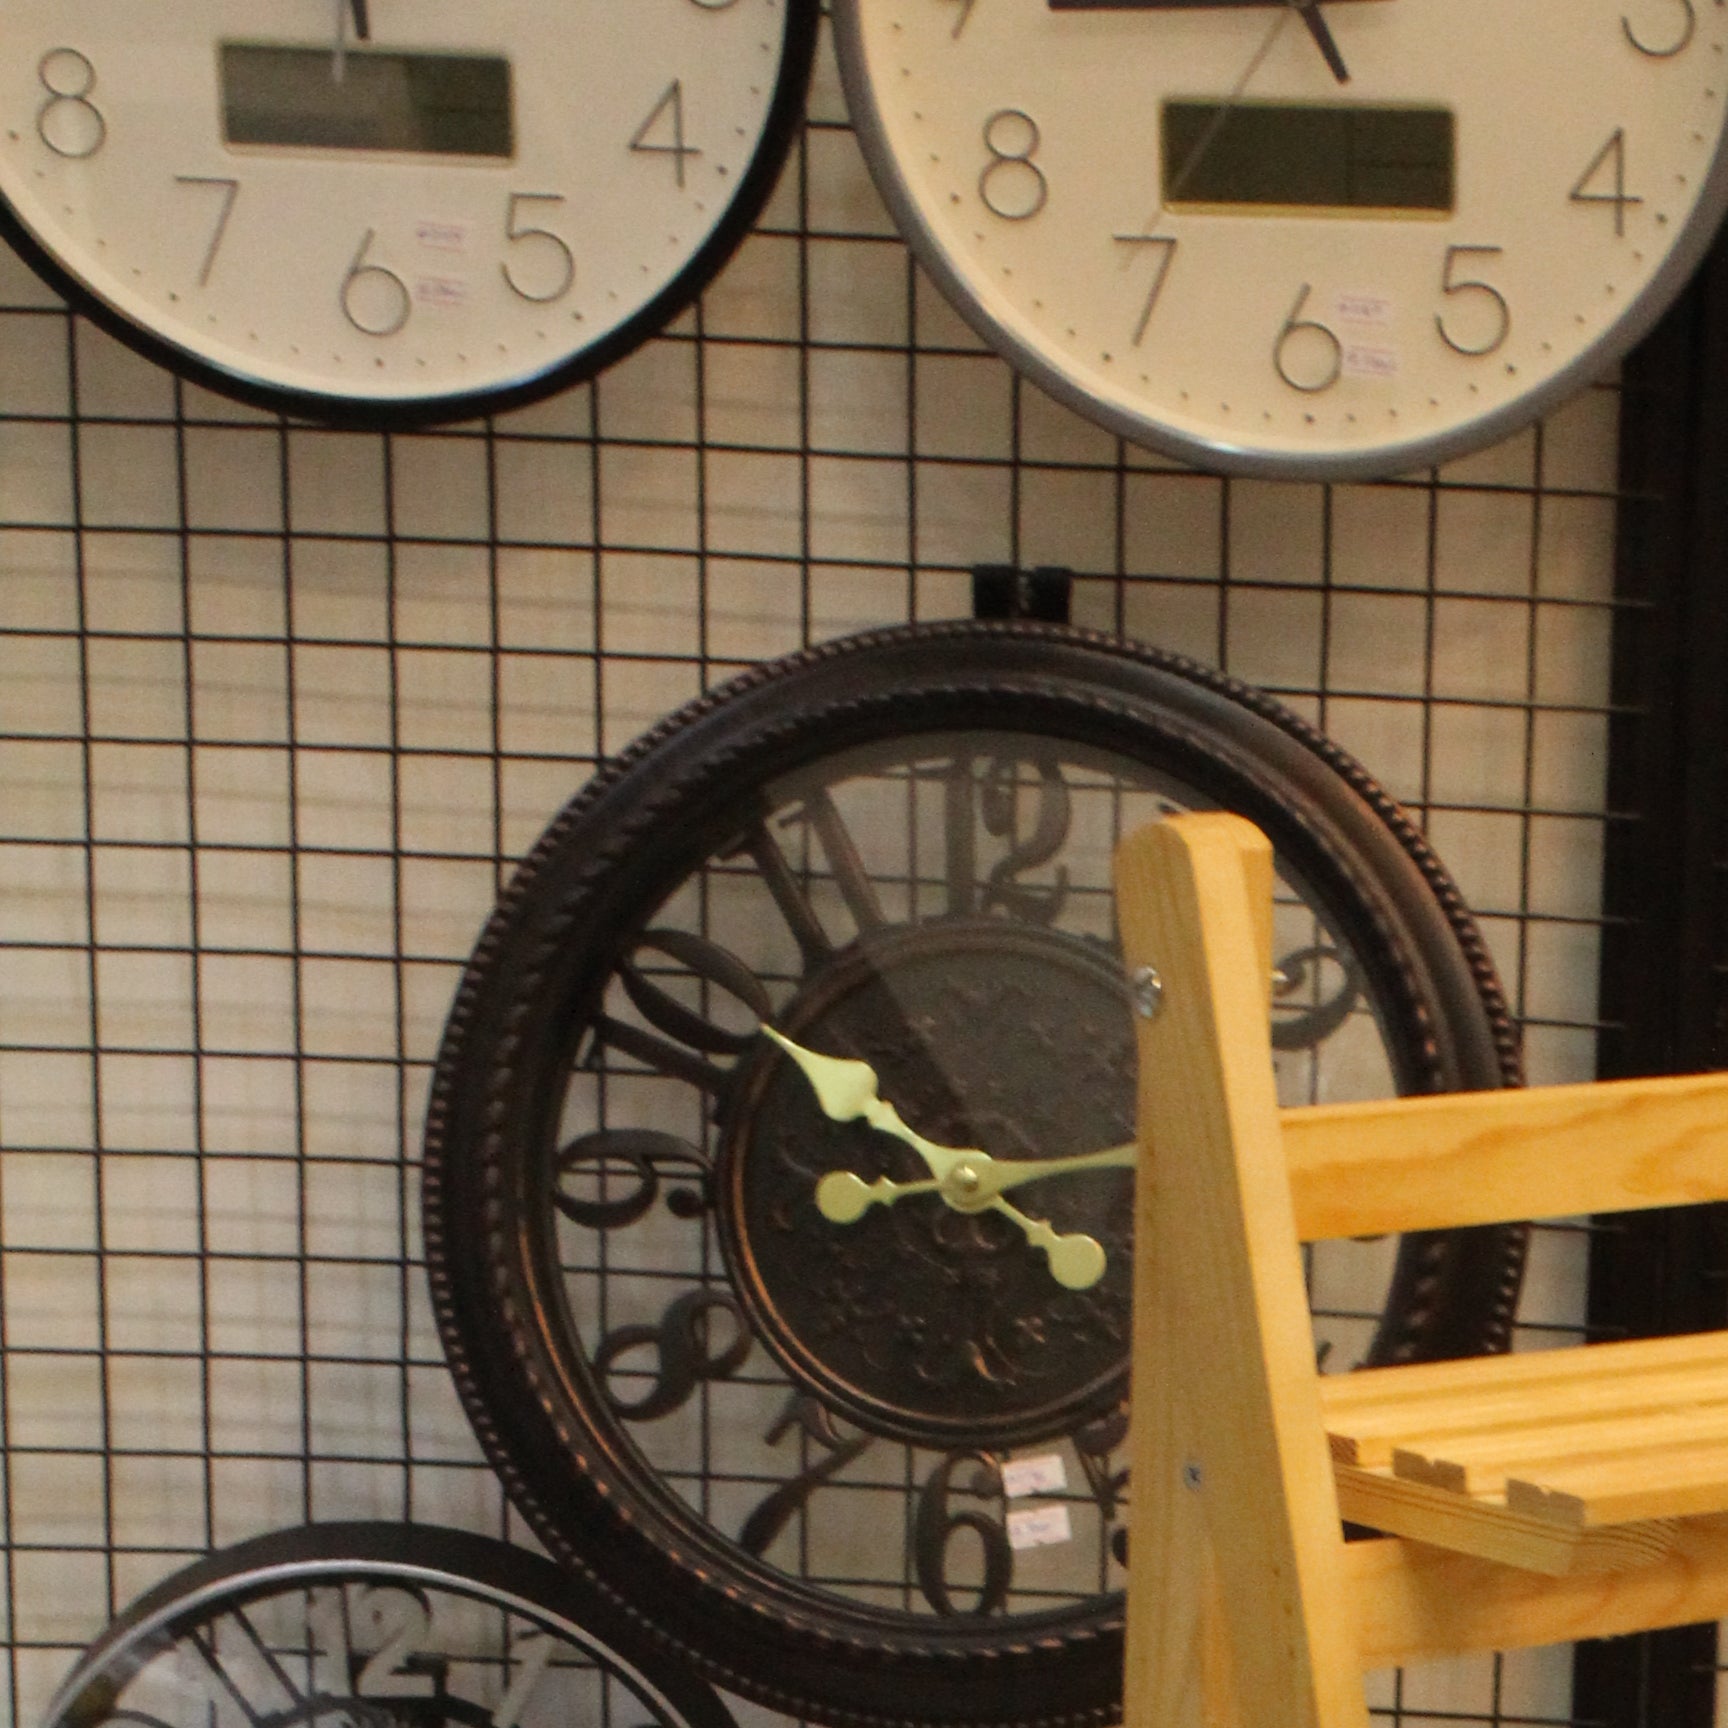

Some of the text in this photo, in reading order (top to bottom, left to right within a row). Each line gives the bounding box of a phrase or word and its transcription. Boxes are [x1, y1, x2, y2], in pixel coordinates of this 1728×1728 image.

[37, 47, 106, 158] 8
[628, 78, 702, 188] 4
[978, 109, 1047, 219] 8
[1569, 127, 1643, 237] 4
[175, 174, 240, 287] 7
[340, 228, 410, 336] 6
[500, 192, 575, 302] 5
[1112, 234, 1177, 346] 7
[1274, 283, 1342, 391] 6
[1435, 245, 1510, 355] 5
[946, 752, 1072, 925] 12
[556, 1128, 712, 1230] 9
[598, 1288, 750, 1420] 8
[738, 1390, 880, 1560] 7
[917, 1448, 1012, 1618] 6
[325, 1583, 437, 1697] 12
